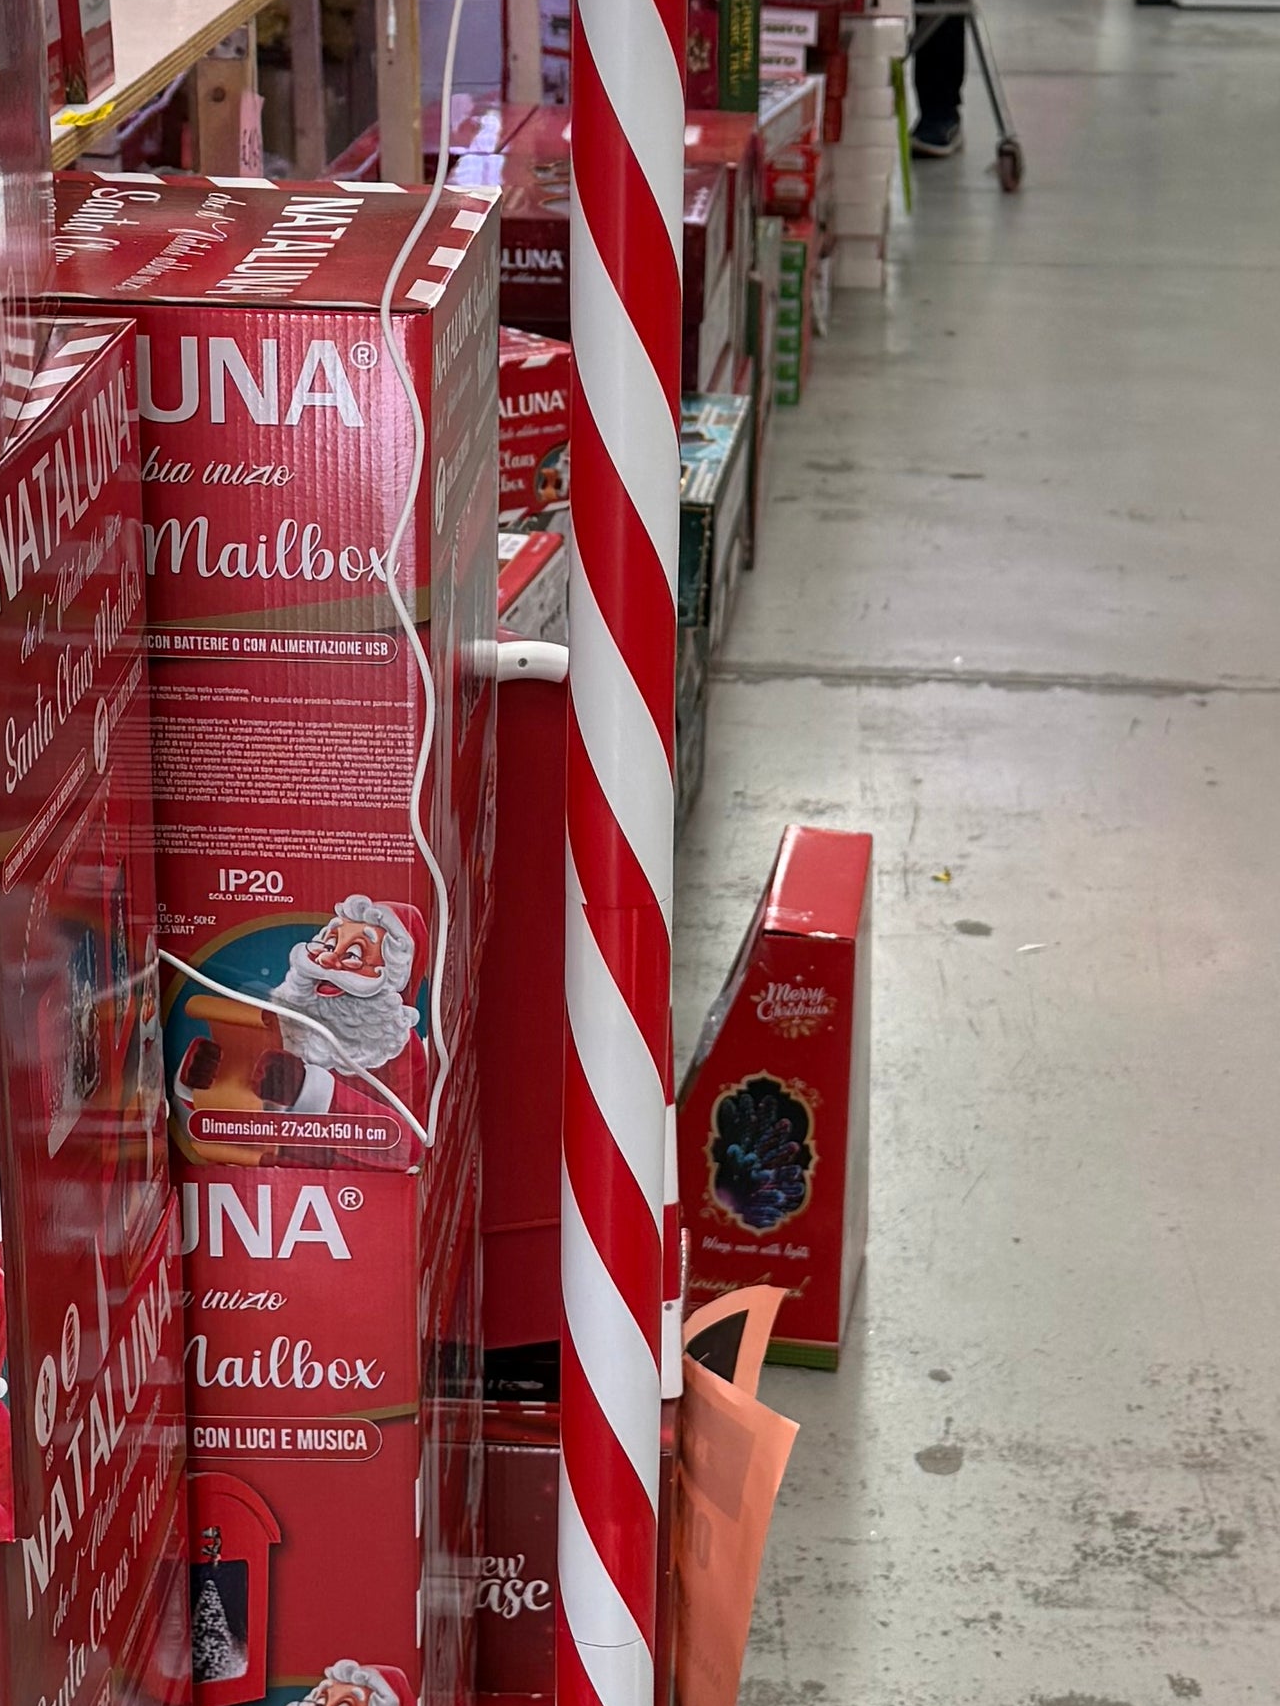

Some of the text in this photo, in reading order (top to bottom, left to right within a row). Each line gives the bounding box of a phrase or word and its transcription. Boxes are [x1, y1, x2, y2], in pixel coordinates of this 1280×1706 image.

[202, 448, 296, 488] inizio
[174, 635, 230, 652] BATTERIE
[232, 637, 240, 652] O
[243, 637, 267, 653] CON
[269, 638, 362, 656] ALIMENTAZIONE
[365, 640, 389, 657] USB
[218, 867, 284, 894] IP20
[201, 1116, 388, 1143] Dimensioni: 27x20x150 h cm
[201, 1288, 288, 1312] inizio
[193, 1426, 368, 1452] CON LUCI E MUSICA
